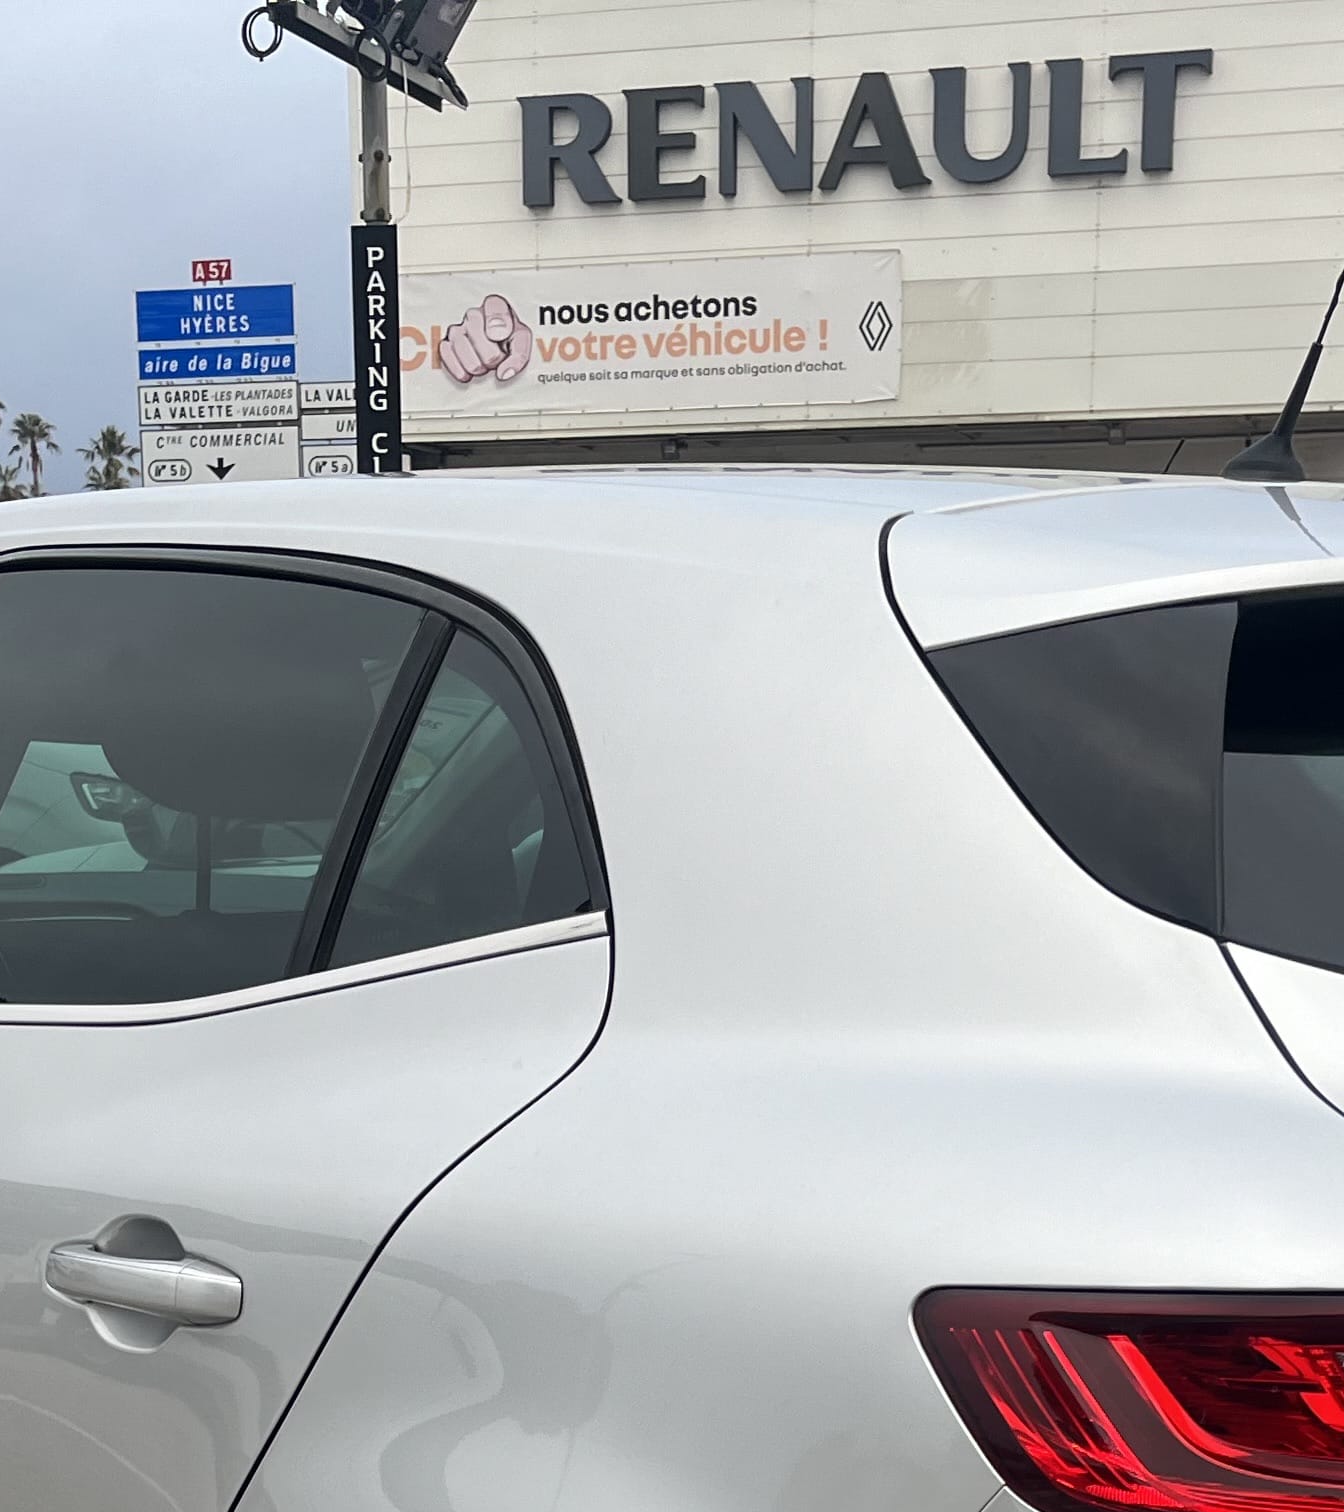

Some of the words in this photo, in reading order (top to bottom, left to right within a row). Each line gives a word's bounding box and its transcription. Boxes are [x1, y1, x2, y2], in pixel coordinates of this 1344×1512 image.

[517, 48, 1213, 208] RENAULT
[193, 292, 235, 312] NICE
[539, 302, 609, 325] nous
[613, 293, 758, 322] achetons
[180, 314, 250, 335] HYÈRES
[367, 246, 388, 411] PARKING
[536, 330, 637, 362] votre
[642, 318, 806, 359] véhicule
[144, 356, 179, 373] aire
[187, 354, 208, 371] de
[216, 353, 233, 370] la
[241, 352, 292, 373] Bigue
[537, 371, 587, 384] quelque
[589, 370, 612, 381] soit
[614, 372, 629, 380] sa
[630, 369, 679, 381] marque
[680, 367, 694, 377] et
[696, 365, 726, 377] sans
[727, 362, 792, 377] obligation
[144, 391, 160, 404] LA
[164, 389, 209, 403] GARDE
[234, 388, 293, 401] PLANTADES
[305, 389, 322, 402] LA
[326, 388, 356, 401] VAL
[145, 407, 162, 420] LA
[169, 404, 233, 419] VALETTE
[189, 432, 285, 448] COMMERCIAL
